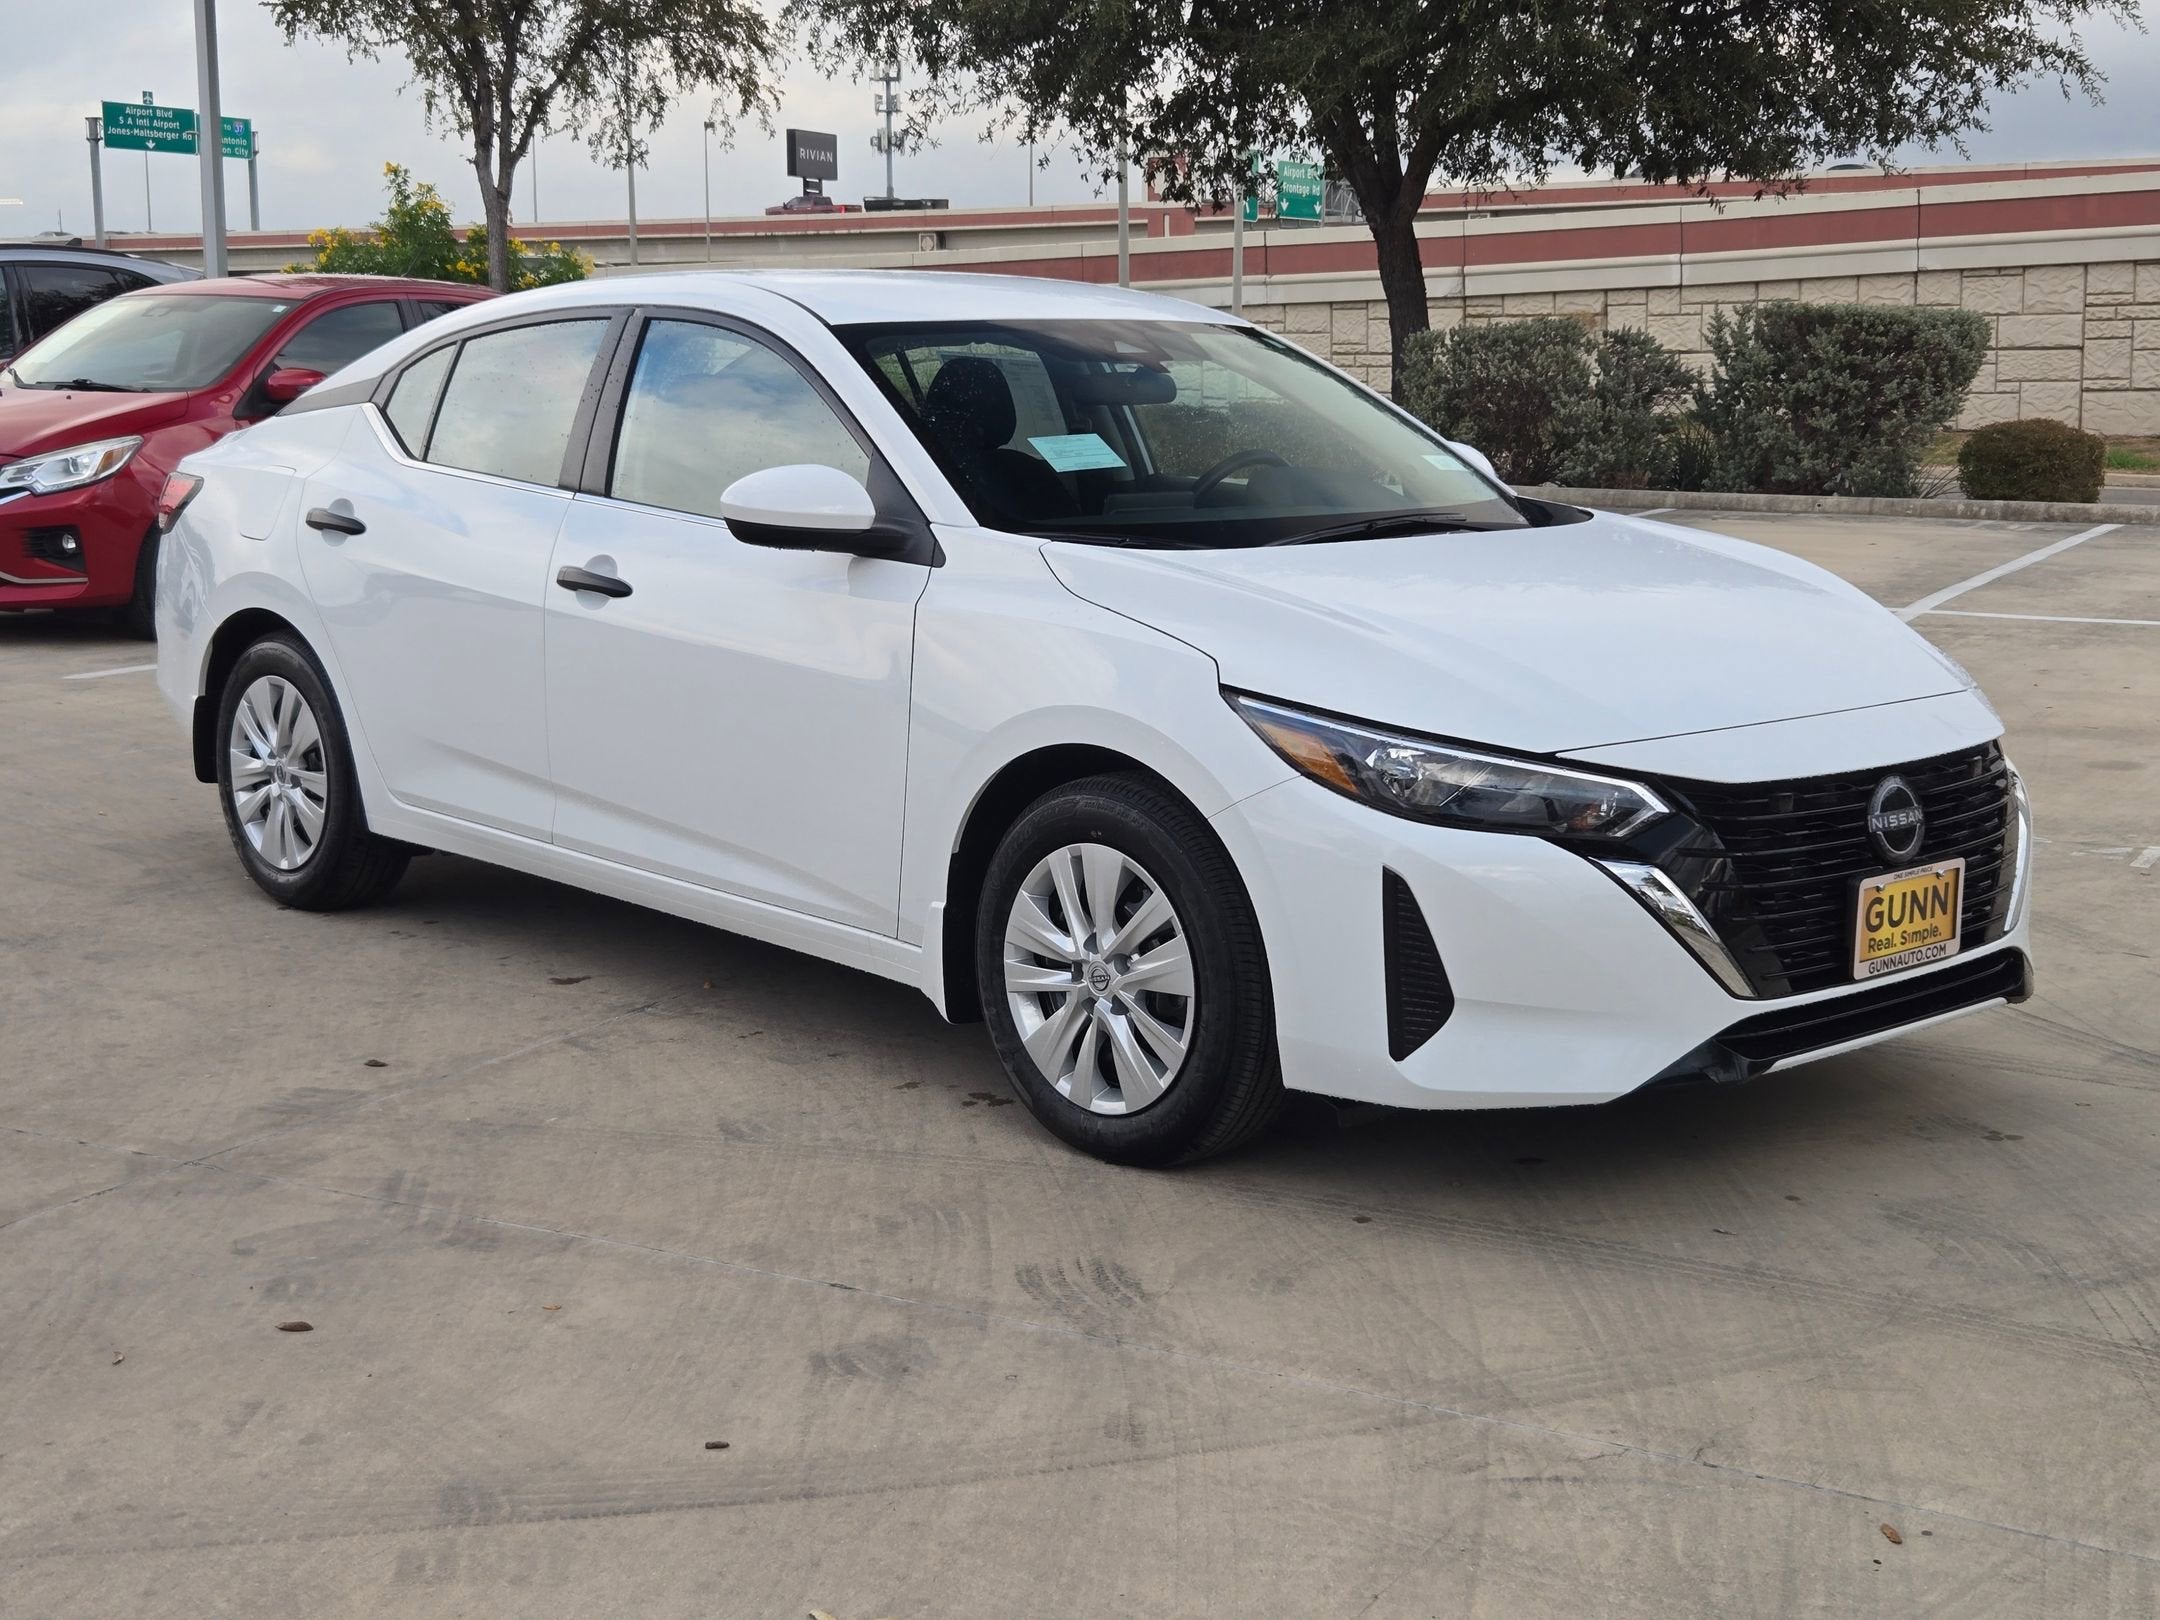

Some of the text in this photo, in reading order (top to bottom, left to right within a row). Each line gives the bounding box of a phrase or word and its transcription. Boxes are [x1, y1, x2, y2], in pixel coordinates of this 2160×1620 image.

[125, 106, 173, 119] Airport Blvd
[119, 116, 180, 130] S A Intl Airport
[107, 126, 179, 140] Jones-Maltsberger
[222, 137, 247, 146] ntonio
[234, 148, 248, 158] City
[800, 148, 833, 162] RIVIAN
[1283, 165, 1304, 180] Airport
[1871, 808, 1923, 830] NISSAN
[1865, 882, 1950, 933] GUNN
[1868, 932, 1897, 953] Real.
[1868, 943, 1946, 974] GUNNAUTO.COM
